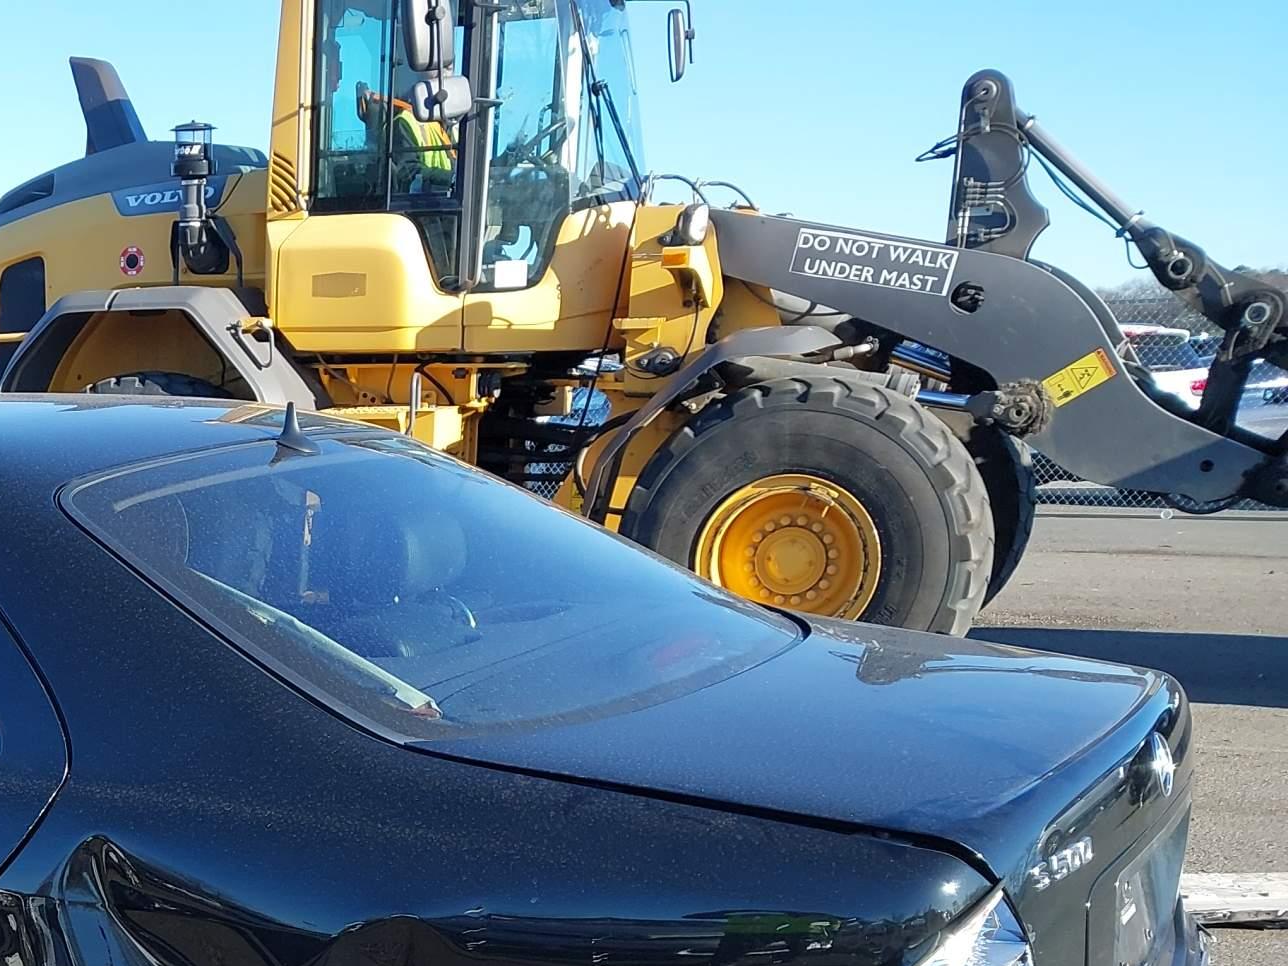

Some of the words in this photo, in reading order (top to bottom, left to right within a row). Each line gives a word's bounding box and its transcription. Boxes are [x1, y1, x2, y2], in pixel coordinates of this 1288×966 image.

[799, 233, 831, 251] DO
[836, 238, 884, 258] NOT
[890, 246, 951, 269] WALK
[804, 258, 874, 282] UNDER
[879, 270, 938, 292] MAST
